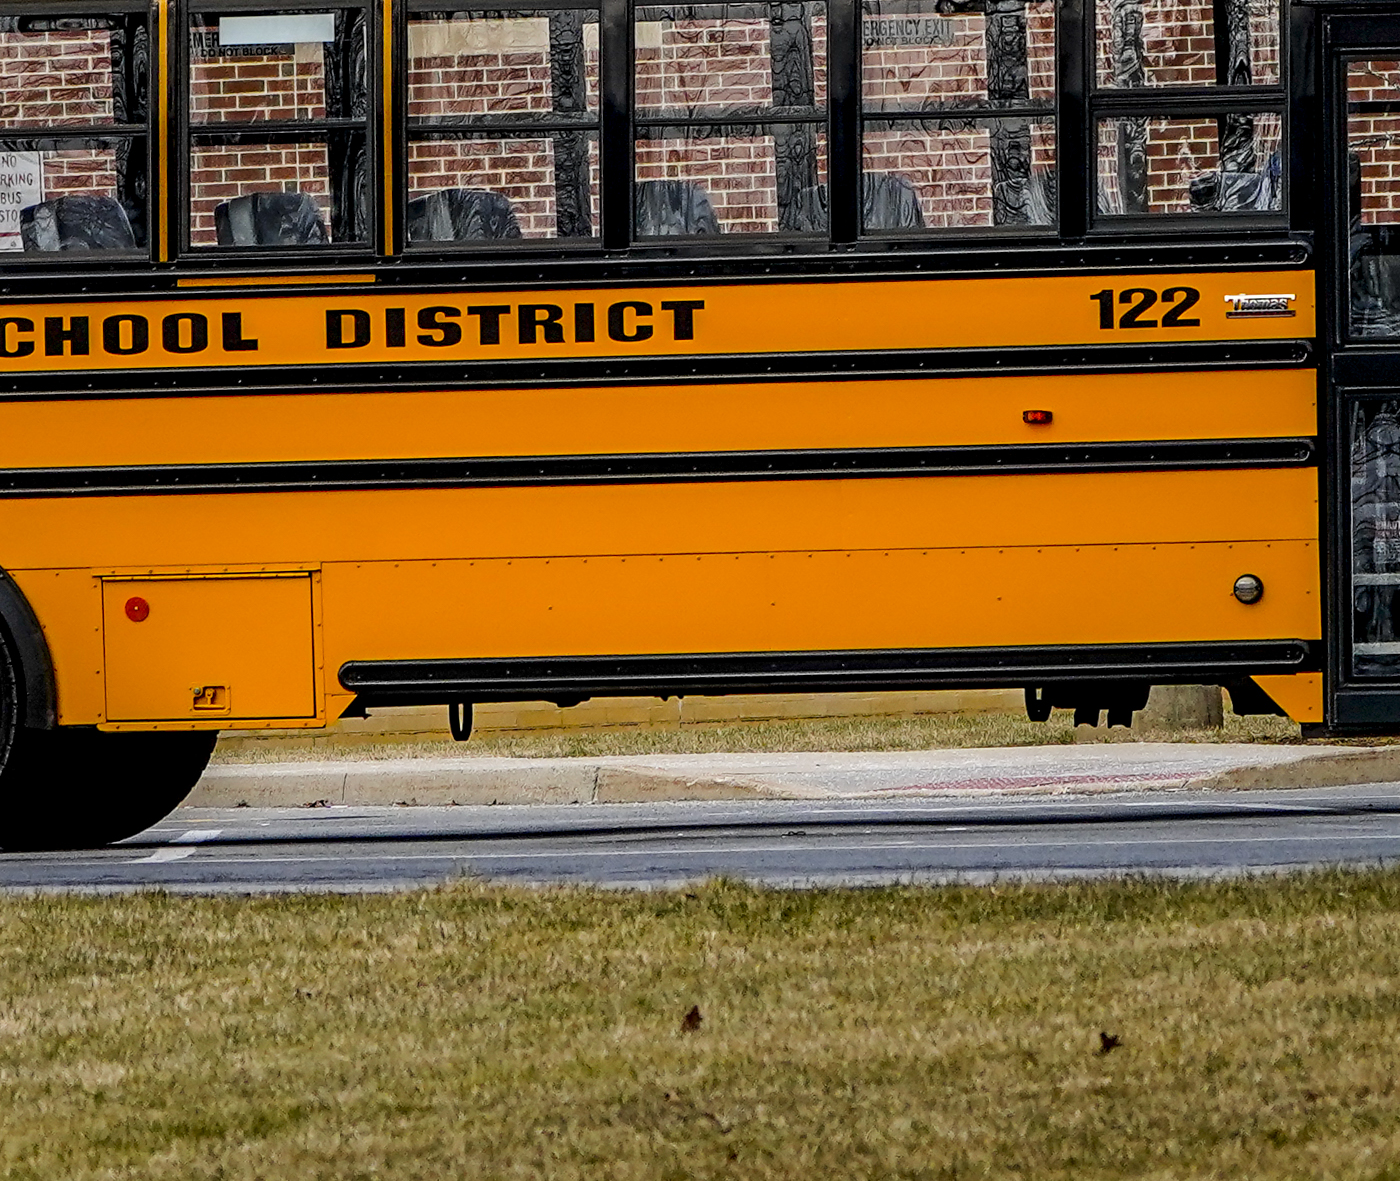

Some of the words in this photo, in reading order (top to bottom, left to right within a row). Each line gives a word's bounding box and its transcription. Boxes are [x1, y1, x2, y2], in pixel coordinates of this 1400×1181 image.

[862, 18, 920, 36] ERGENCY
[925, 18, 951, 35] EXIT
[218, 48, 240, 57] NOT
[243, 46, 279, 56] BLOCK
[1, 155, 17, 168] NO
[0, 191, 22, 204] BUS
[1089, 286, 1201, 330] 122
[325, 300, 705, 350] DISTRICT
